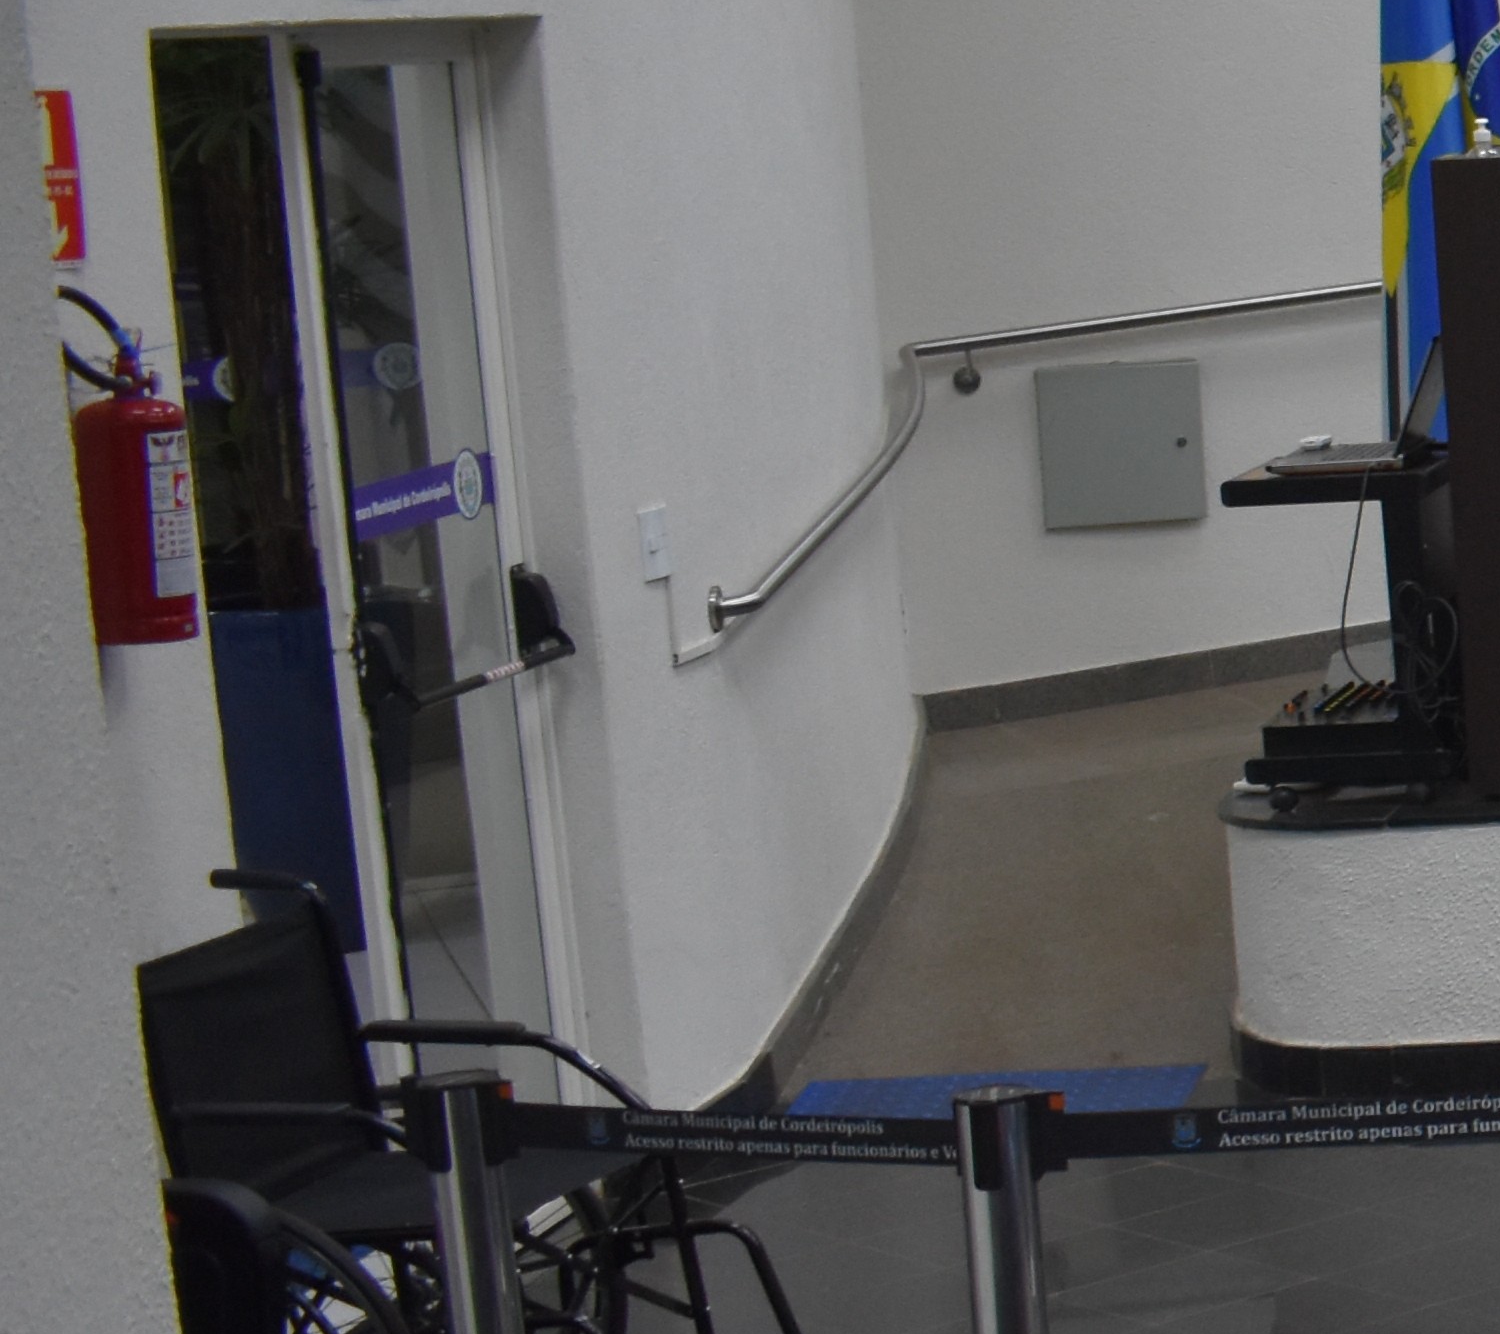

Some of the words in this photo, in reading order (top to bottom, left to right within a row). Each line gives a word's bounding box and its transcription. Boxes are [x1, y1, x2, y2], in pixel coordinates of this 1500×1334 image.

[622, 1110, 678, 1127] Câmara
[680, 1112, 756, 1133] Municipal
[759, 1115, 778, 1131] de
[780, 1117, 884, 1137] Cordeirópolis
[1217, 1108, 1286, 1124] Câmara
[1291, 1100, 1381, 1120] Municipal
[1385, 1097, 1408, 1114] de
[625, 1135, 674, 1150] Acesso
[677, 1135, 734, 1152] restrito
[736, 1140, 790, 1156] apenas
[794, 1142, 829, 1158] para
[830, 1141, 928, 1159] funcionários
[932, 1149, 939, 1159] e
[1218, 1132, 1280, 1148] Acesso
[1285, 1127, 1354, 1145] restrito
[1358, 1123, 1424, 1142] apenas
[1427, 1120, 1468, 1140] para
